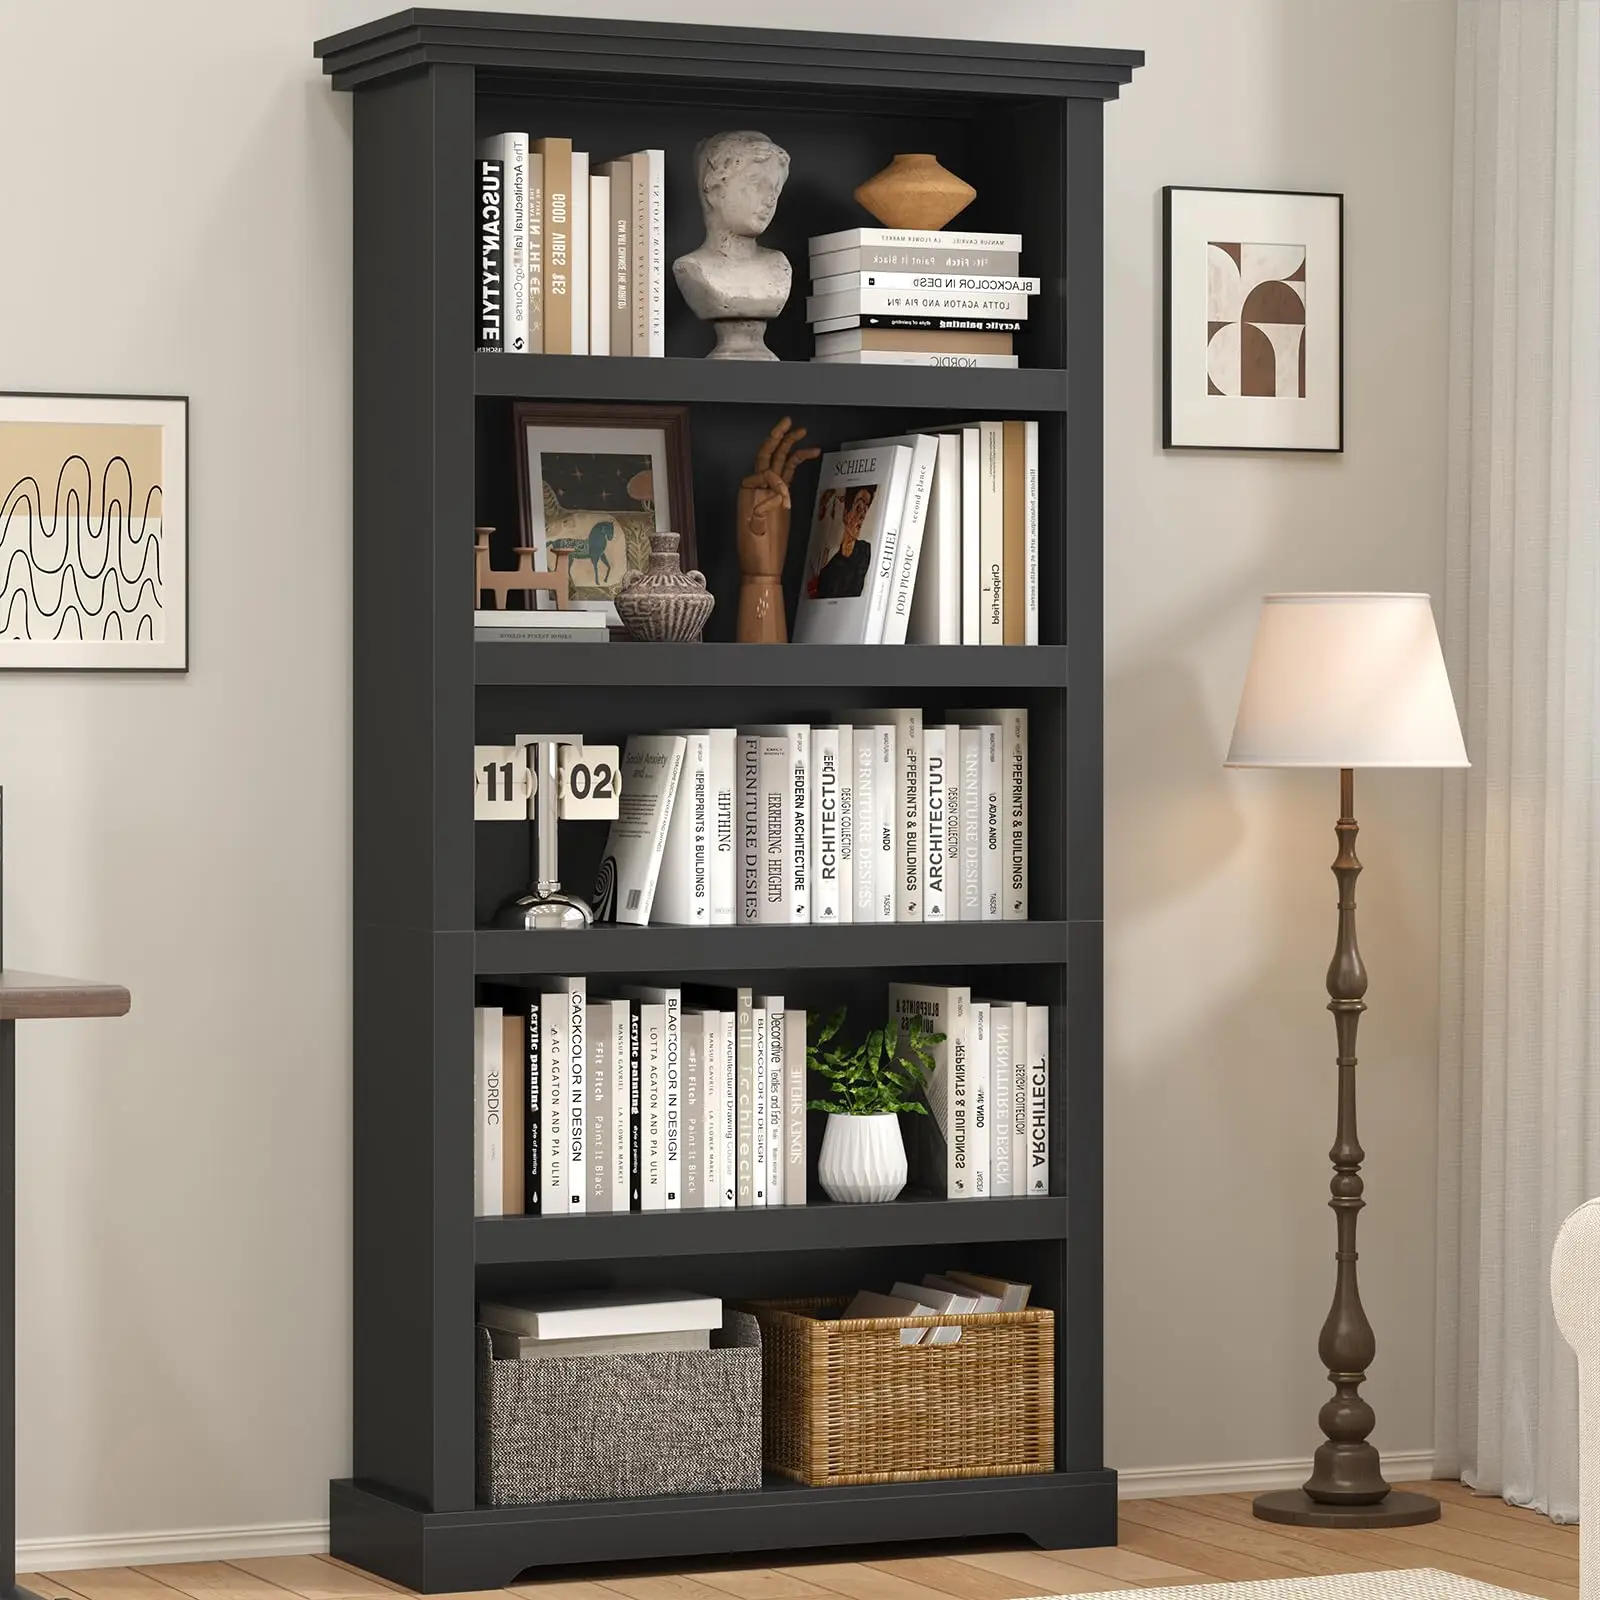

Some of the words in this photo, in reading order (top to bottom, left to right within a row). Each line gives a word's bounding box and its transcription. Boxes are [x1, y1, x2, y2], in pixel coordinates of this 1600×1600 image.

[834, 458, 877, 476] SCHIELE
[912, 494, 922, 524] second
[918, 464, 927, 492] glance
[896, 591, 908, 616] JODI
[633, 767, 644, 778] and
[643, 753, 668, 768] Anxiety
[483, 762, 513, 801] 11
[570, 763, 612, 799] 02
[746, 739, 757, 848] FURNITURE
[841, 788, 851, 814] DESIGN
[948, 787, 957, 814] DESIGN
[841, 816, 851, 860] COLLECTION
[882, 828, 890, 851] ANDO
[948, 815, 957, 859] COLLECTION
[1012, 820, 1022, 828] &
[794, 812, 804, 891] ARCHITECTURE
[906, 832, 917, 891] BUILDINGS
[1012, 831, 1022, 890] BUILDINGS
[696, 845, 705, 898] BUILDINGS
[768, 859, 782, 903] HEIGHTS
[966, 846, 977, 907] DESIGN
[529, 1004, 539, 1051] Acrylic
[630, 1014, 639, 1058] Acrylic
[740, 995, 751, 1048] Pelli
[650, 1028, 658, 1060] LOTTA
[771, 1012, 784, 1063] Decorative
[551, 1059, 560, 1105] AGATON
[726, 1040, 734, 1098] Architectural
[572, 1089, 582, 1103] IN
[594, 1070, 604, 1101] Fitch
[630, 1061, 639, 1115] painting
[650, 1066, 658, 1108] AGATON
[668, 1094, 677, 1106] IN
[688, 1076, 696, 1105] Fitch
[618, 1107, 624, 1117] LA
[757, 1103, 764, 1114] IN
[771, 1095, 780, 1108] and
[551, 1110, 560, 1133] AND
[572, 1108, 582, 1162] DESIGN
[594, 1116, 604, 1146] Paint
[650, 1114, 658, 1135] AND
[688, 1118, 696, 1146] Paint
[726, 1101, 734, 1139] Drawing
[551, 1138, 560, 1156] PIA
[650, 1140, 658, 1156] PIA
[668, 1111, 677, 1161] DESIGN
[790, 1118, 802, 1164] SIDNEY
[551, 1161, 560, 1187] ULIN
[594, 1165, 604, 1196] Black
[650, 1161, 658, 1185] ULIN
[688, 1164, 696, 1193] Black
